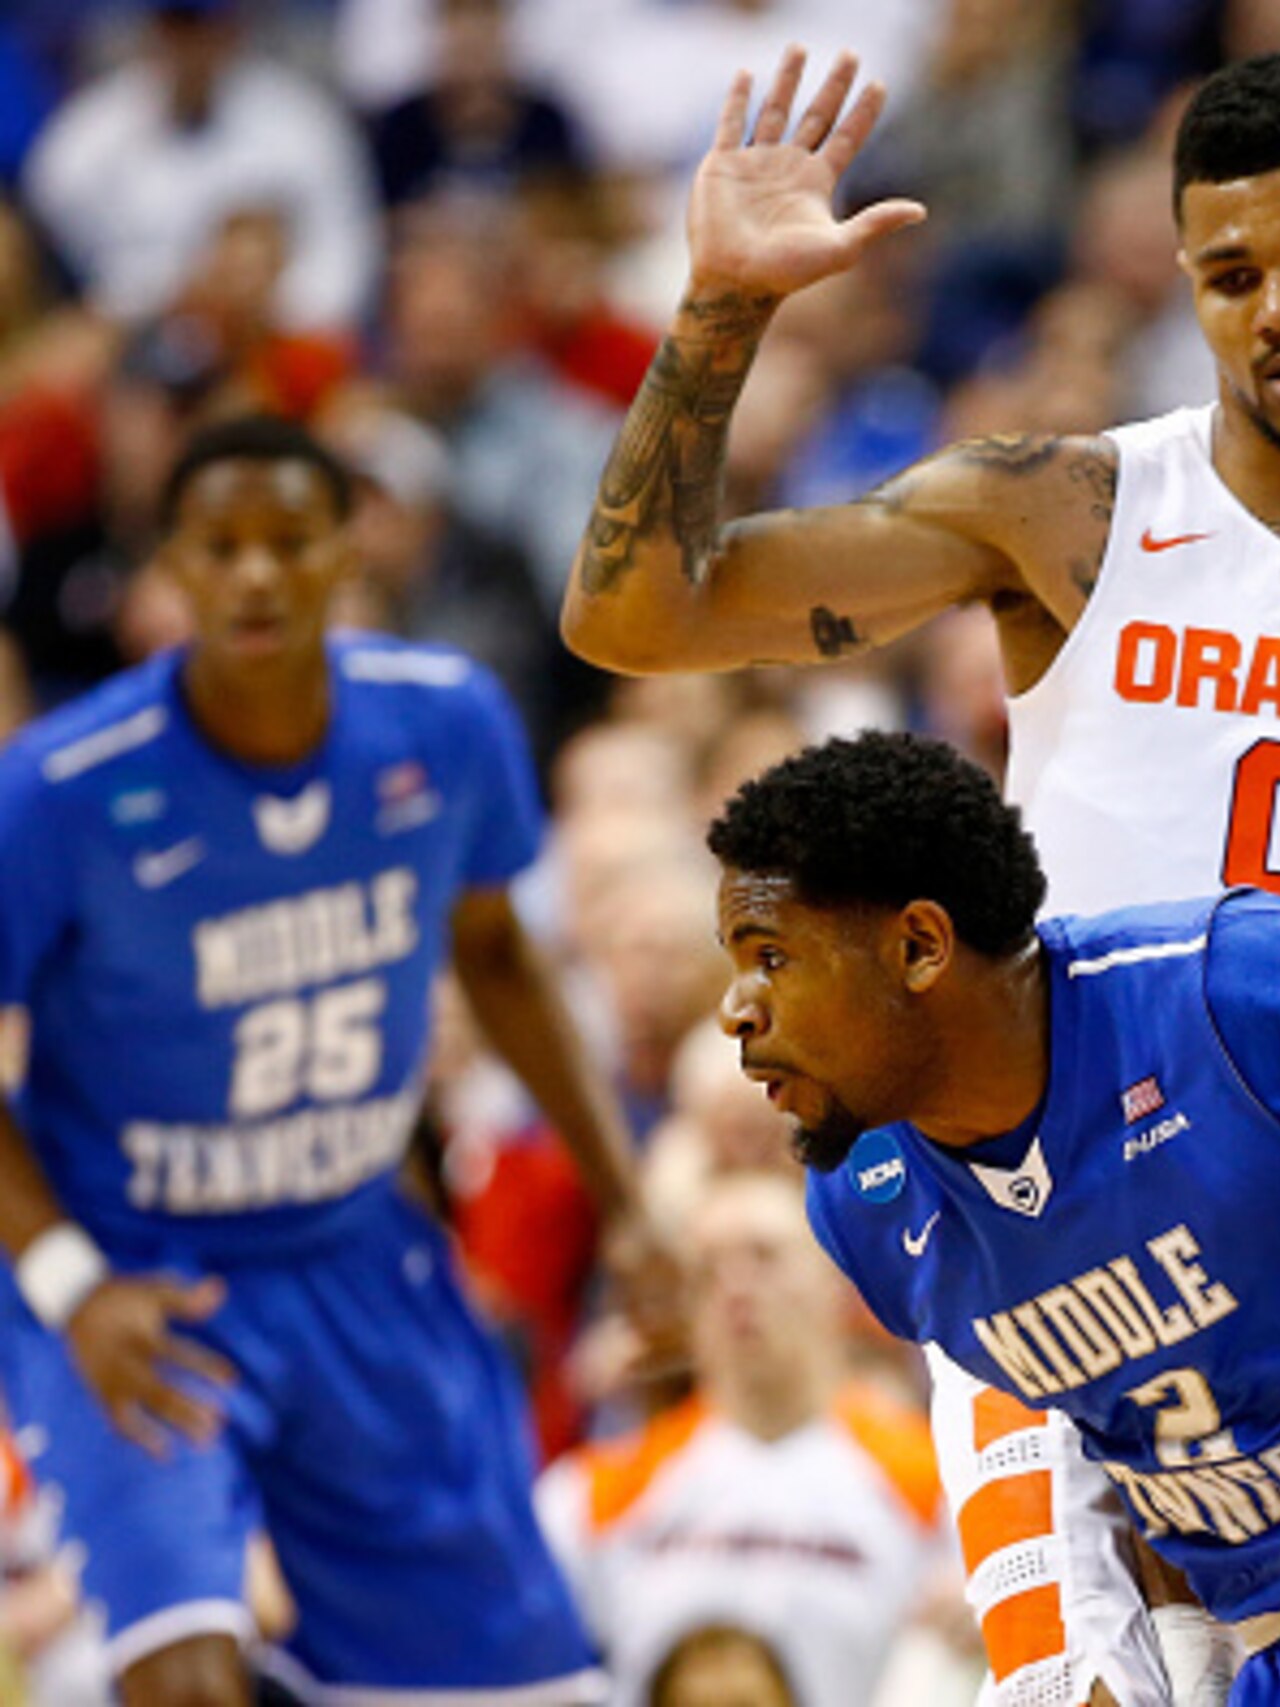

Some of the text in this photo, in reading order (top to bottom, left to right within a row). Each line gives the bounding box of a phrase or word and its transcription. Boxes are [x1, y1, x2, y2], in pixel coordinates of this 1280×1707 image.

[229, 974, 388, 1120] 25
[972, 1223, 1240, 1399] MIDDLE
[1123, 1366, 1246, 1469] 2
